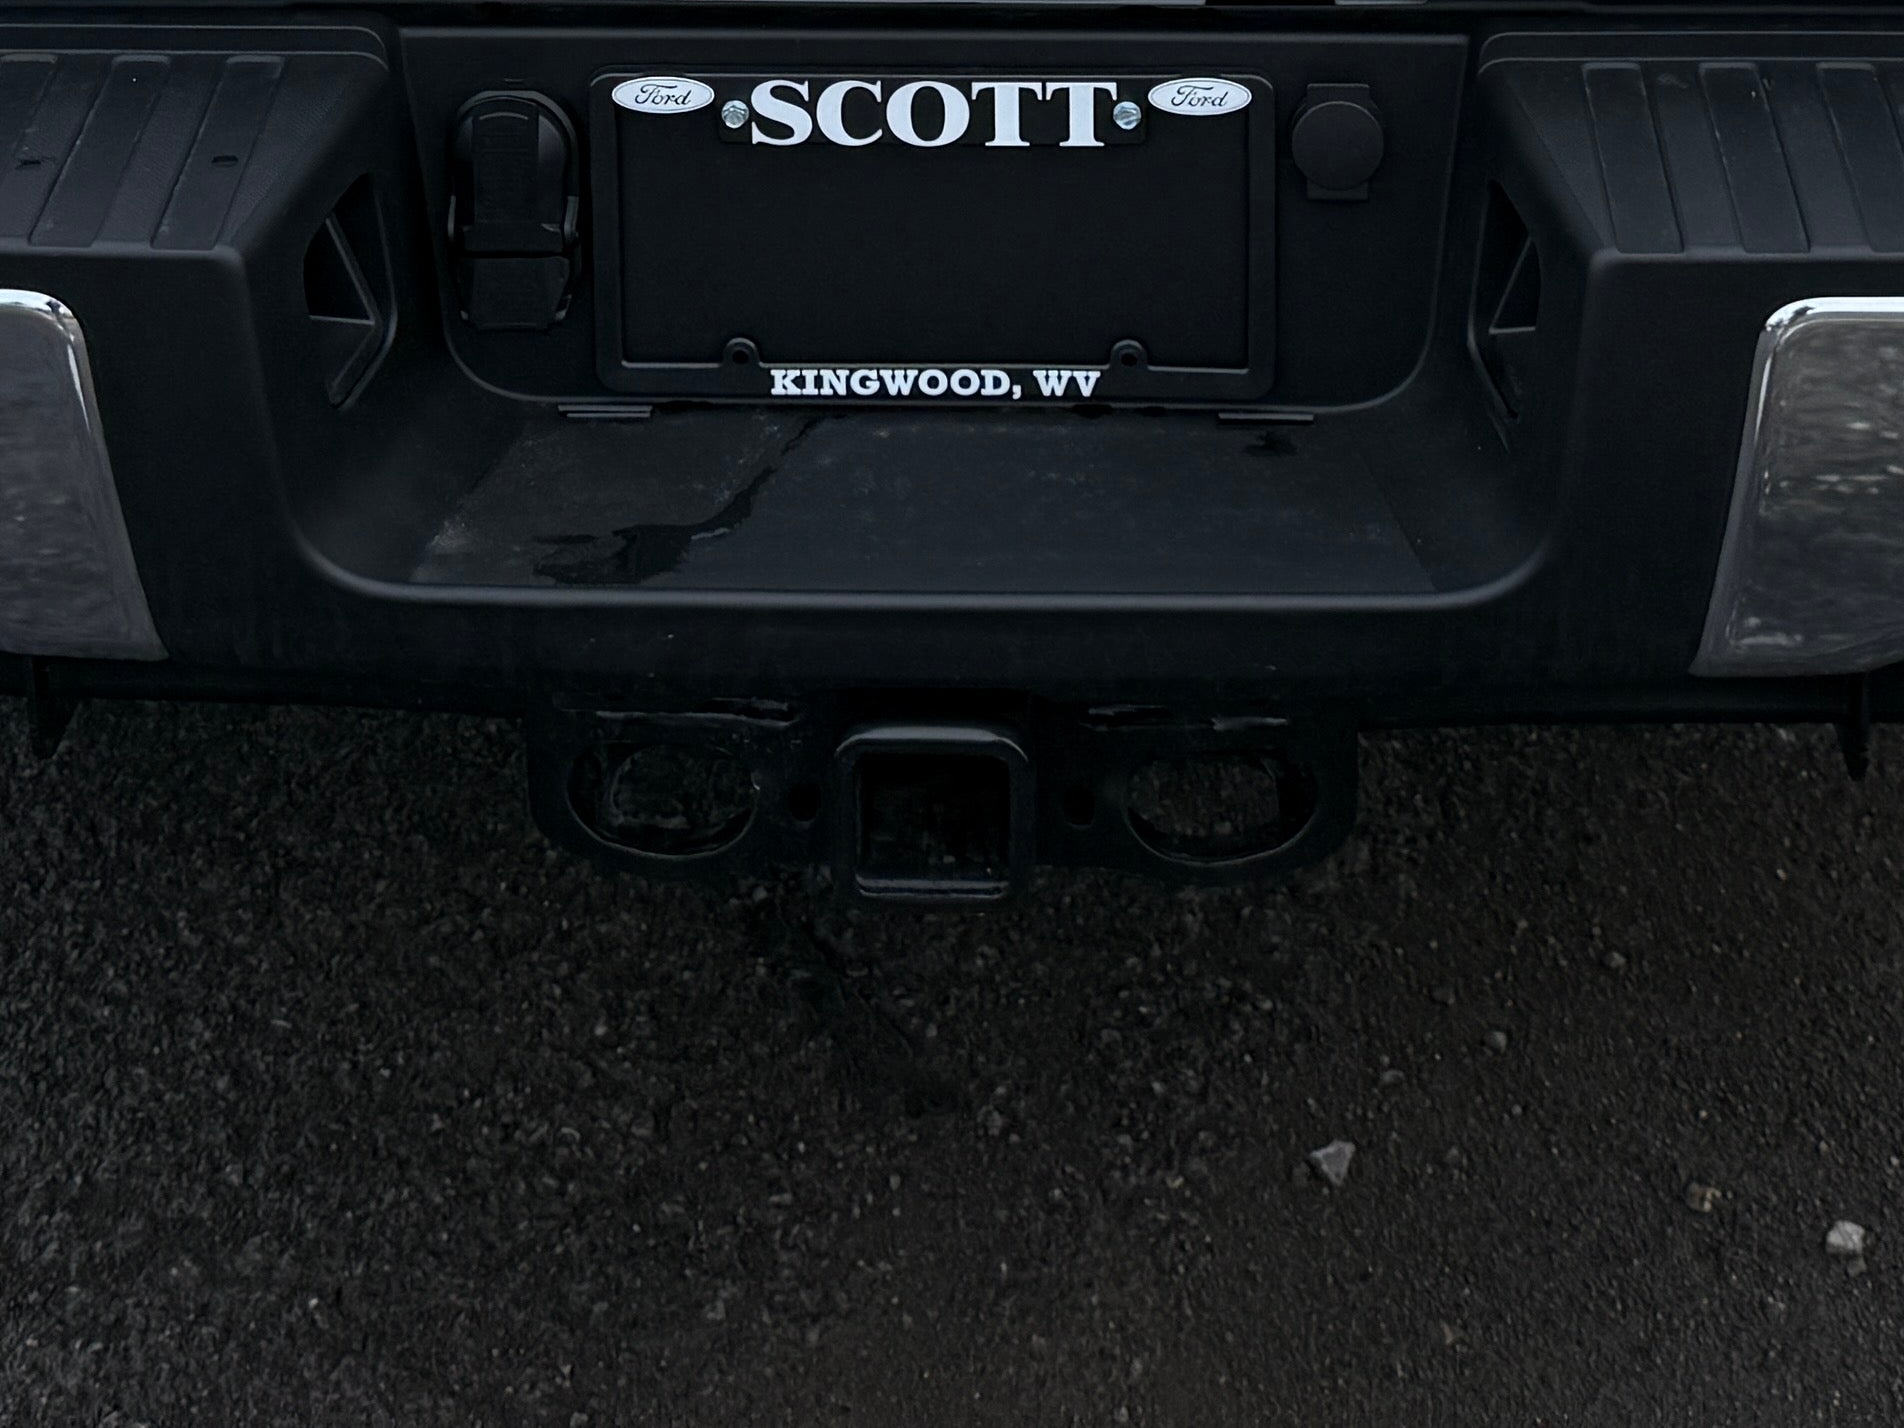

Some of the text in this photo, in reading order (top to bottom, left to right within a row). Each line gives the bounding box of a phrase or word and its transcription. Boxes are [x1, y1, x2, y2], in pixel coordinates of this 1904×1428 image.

[634, 83, 693, 106] Ford
[1170, 84, 1229, 107] Ford
[750, 79, 1117, 148] SCOTT
[769, 368, 1101, 400] KINGWOOD, WV
